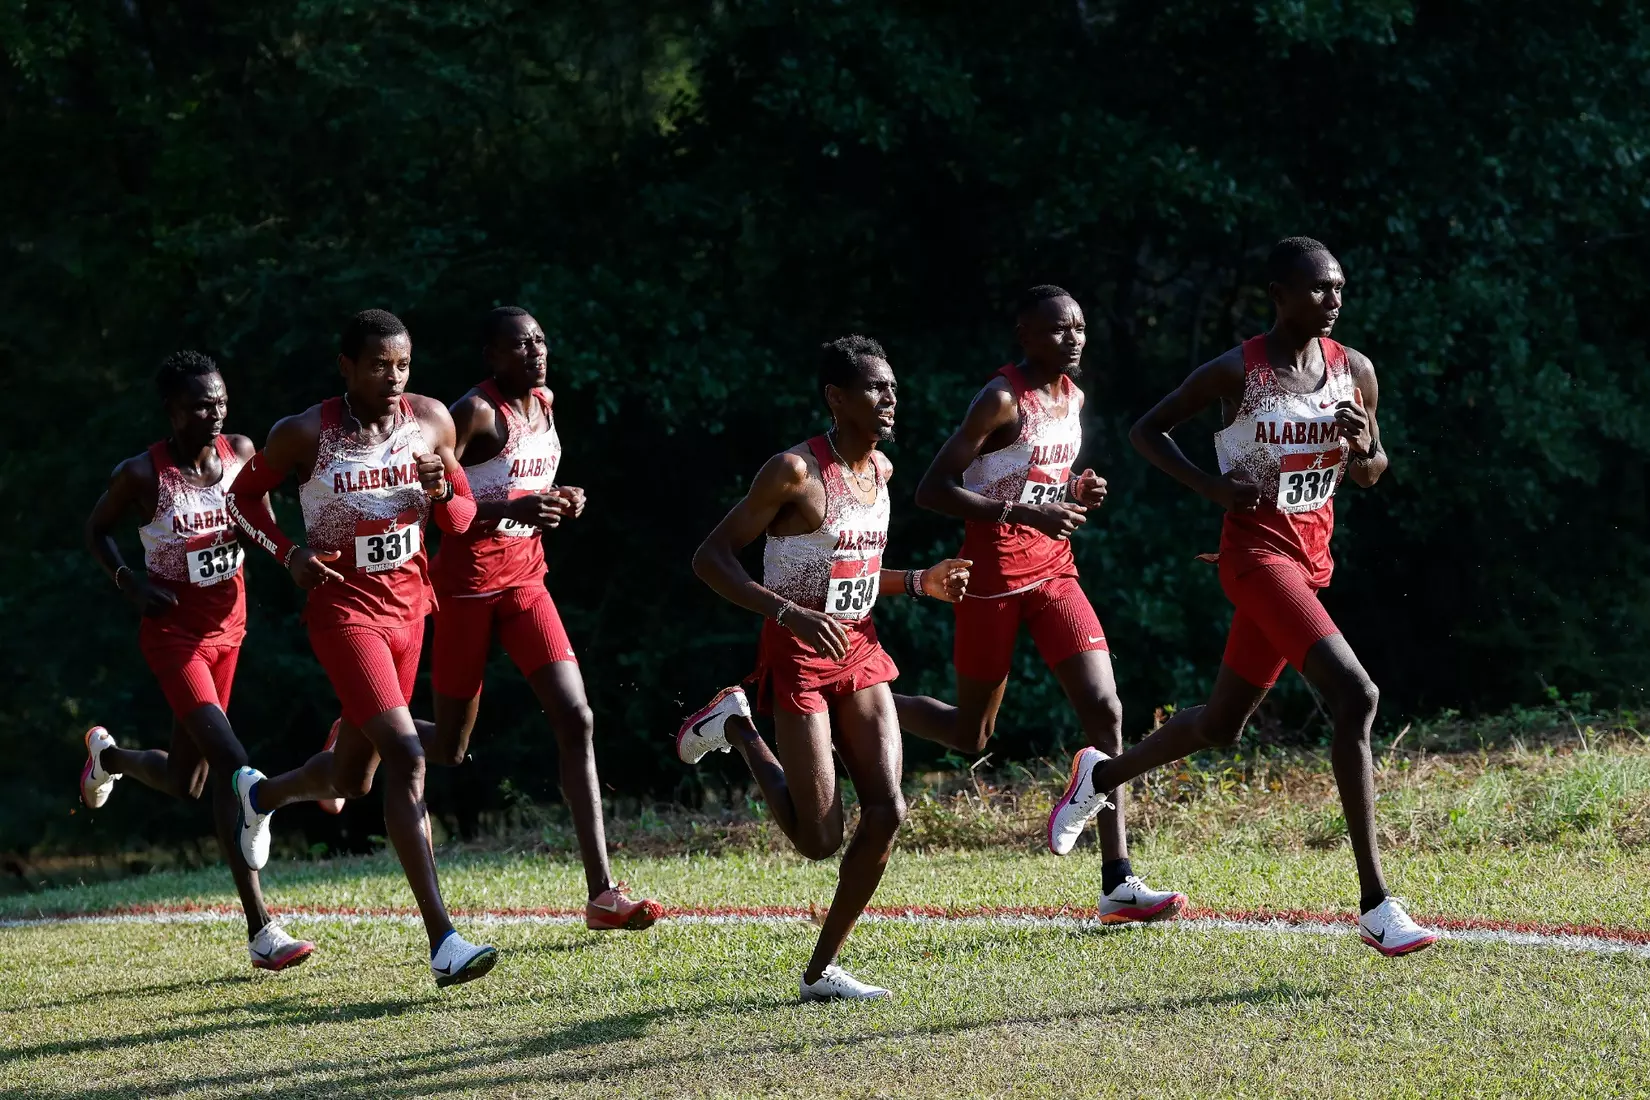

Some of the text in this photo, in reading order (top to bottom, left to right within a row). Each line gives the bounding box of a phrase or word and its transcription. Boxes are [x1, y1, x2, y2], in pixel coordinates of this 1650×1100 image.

[1260, 400, 1276, 412] SEC
[1286, 468, 1334, 505] 338
[227, 492, 278, 555] CRIMSON TIDE
[197, 542, 239, 578] 337
[367, 528, 412, 563] 331
[835, 576, 875, 611] 334
